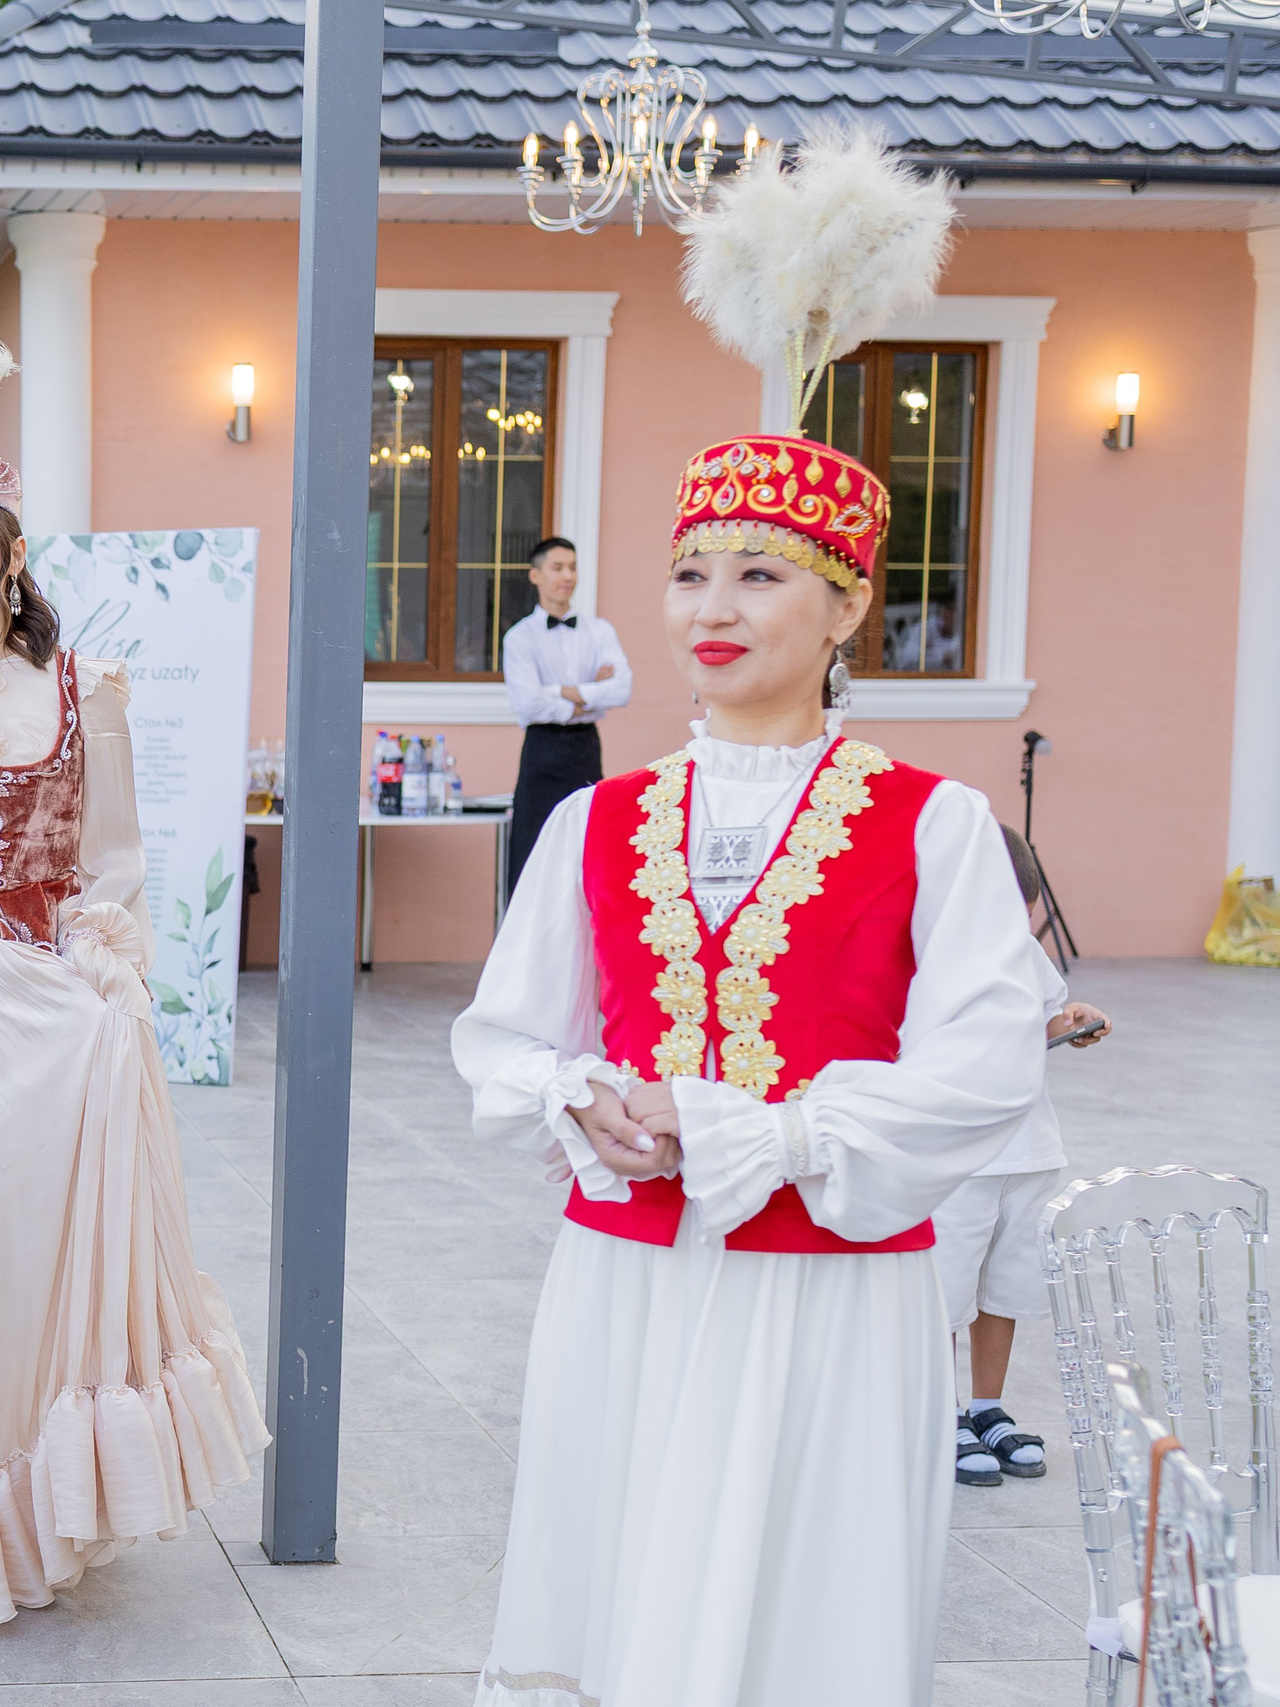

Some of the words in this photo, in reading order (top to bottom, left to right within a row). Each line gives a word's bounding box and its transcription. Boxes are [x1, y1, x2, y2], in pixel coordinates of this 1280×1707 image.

[127, 667, 146, 683] yz
[151, 664, 201, 684] uzaty
[134, 716, 163, 729] Стол
[142, 828, 156, 839] ол
